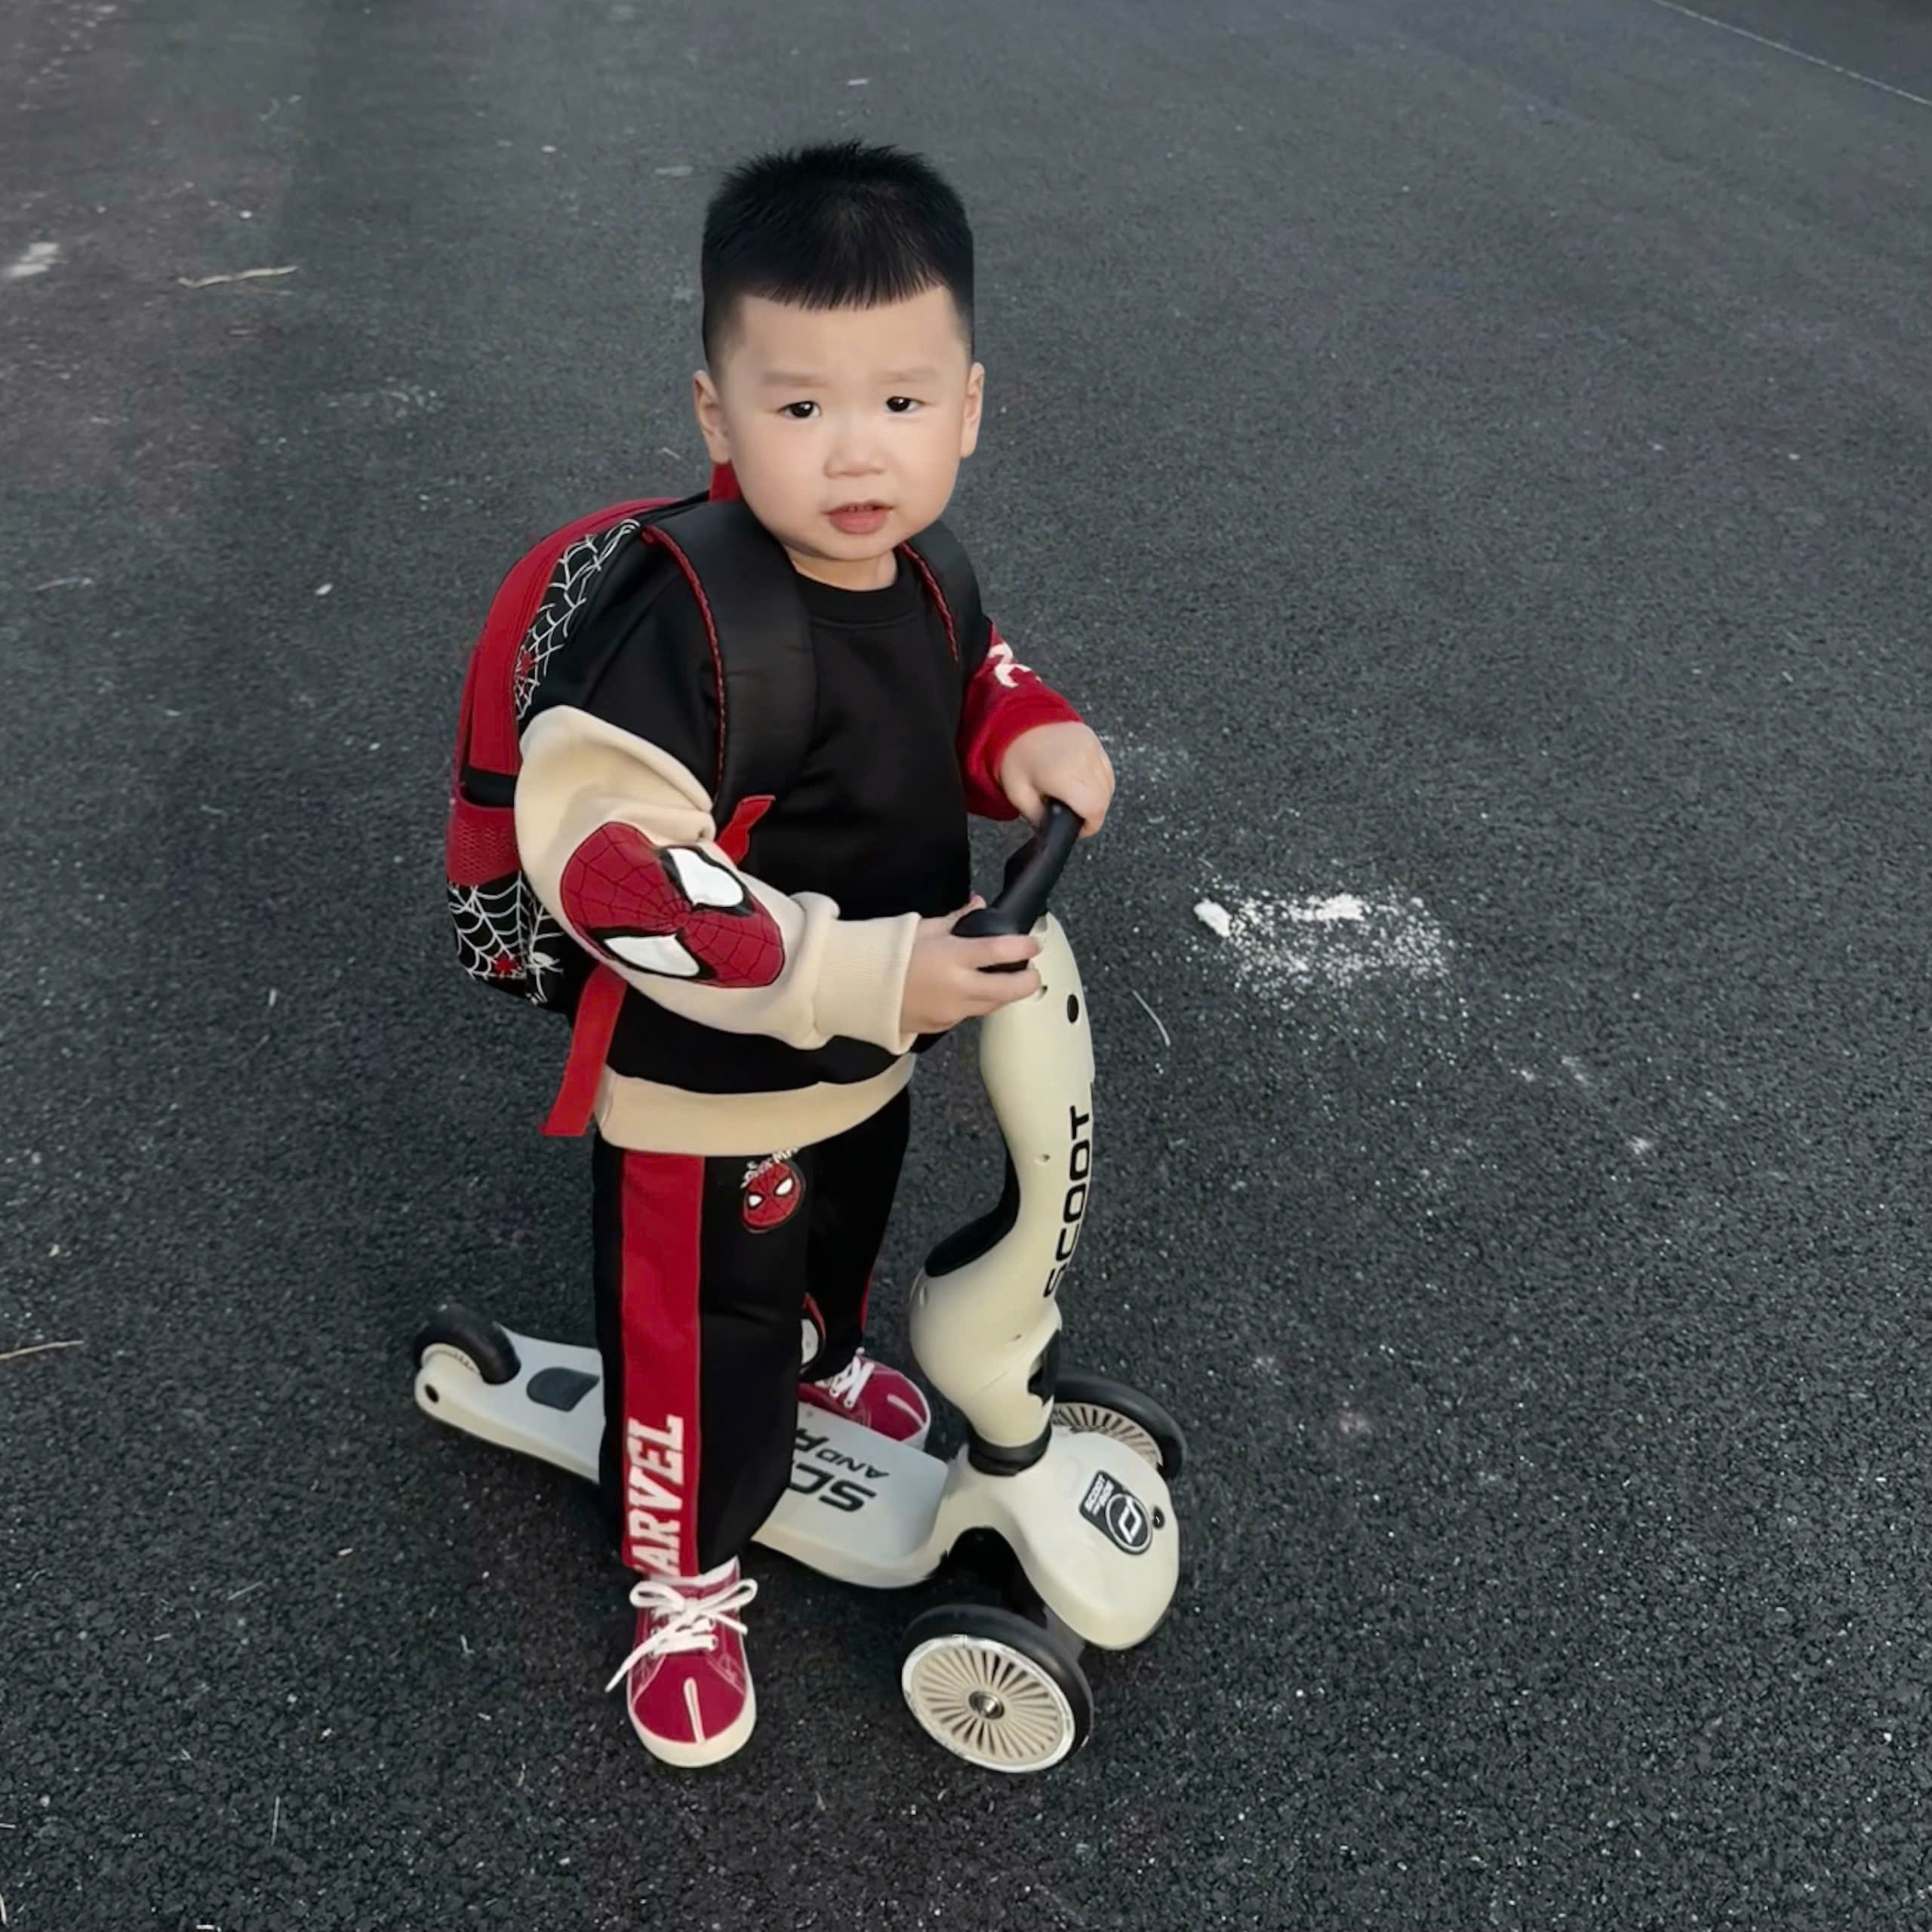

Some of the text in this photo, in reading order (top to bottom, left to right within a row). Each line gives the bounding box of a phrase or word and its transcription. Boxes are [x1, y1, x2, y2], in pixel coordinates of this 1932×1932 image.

[1043, 1105, 1090, 1298] SCOOT
[626, 1414, 684, 1577] ARVEL
[790, 1462, 877, 1512] SC
[815, 1448, 890, 1478] AND
